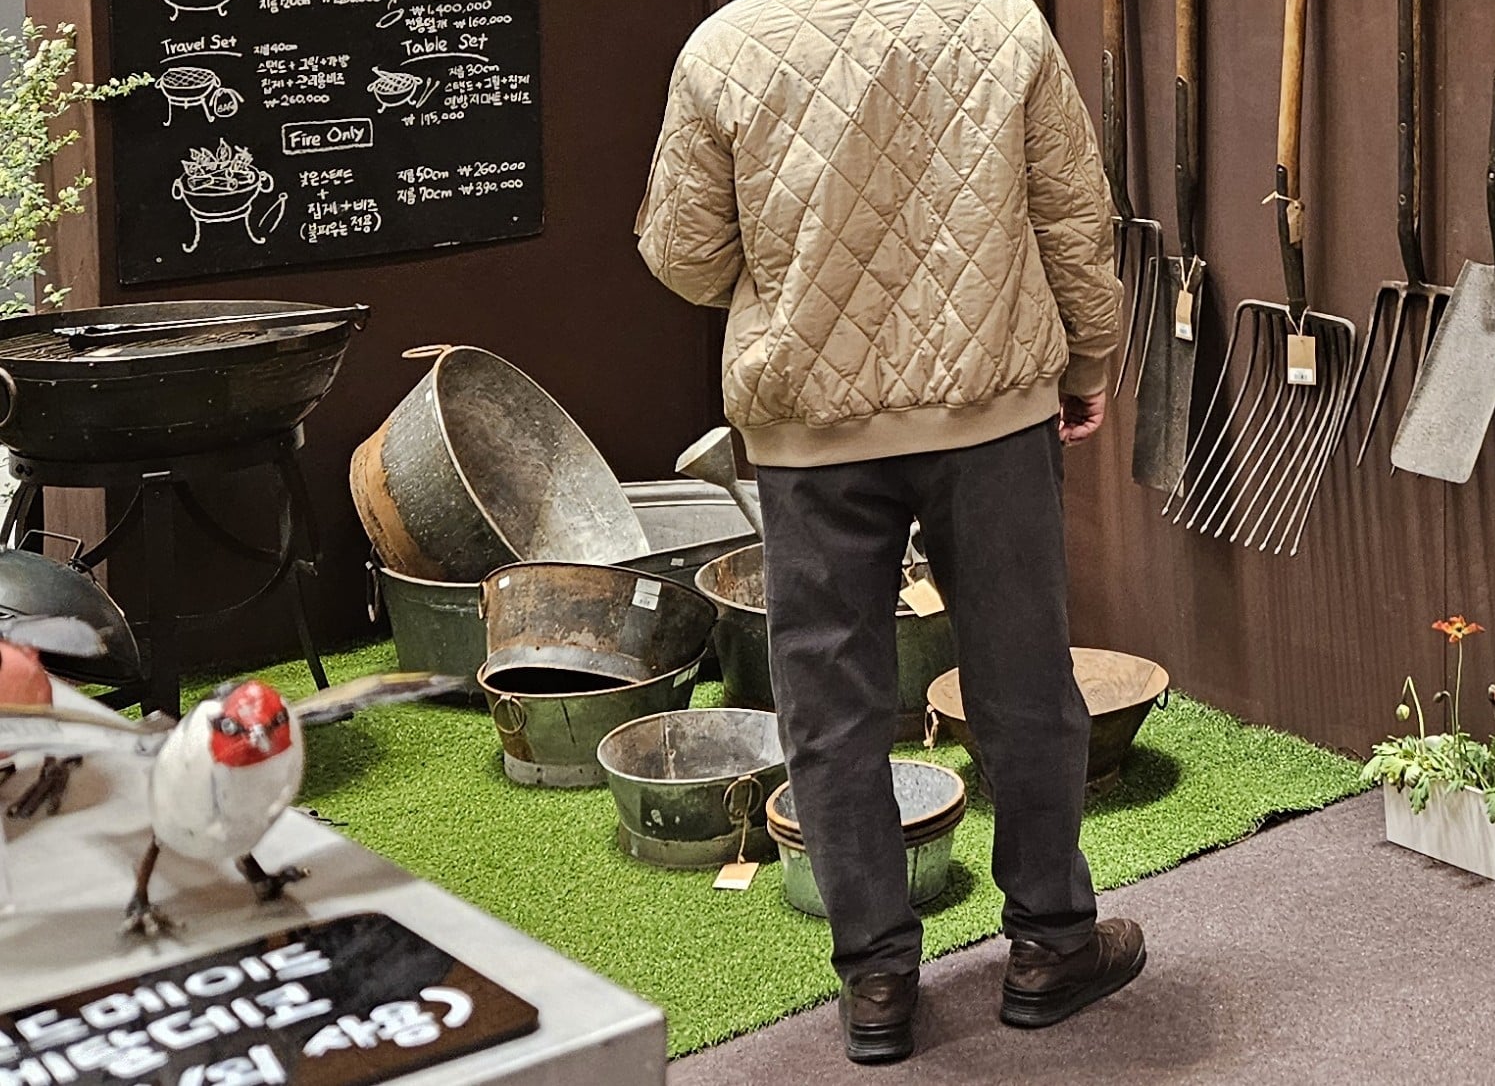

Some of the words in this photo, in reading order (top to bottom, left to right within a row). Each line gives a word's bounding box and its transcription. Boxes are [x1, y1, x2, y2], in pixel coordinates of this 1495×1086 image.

[160, 36, 205, 55] Travel
[209, 34, 237, 50] Set
[400, 35, 448, 56] Table
[458, 33, 488, 50] Set
[289, 130, 321, 148] Fire
[326, 125, 365, 143] Only
